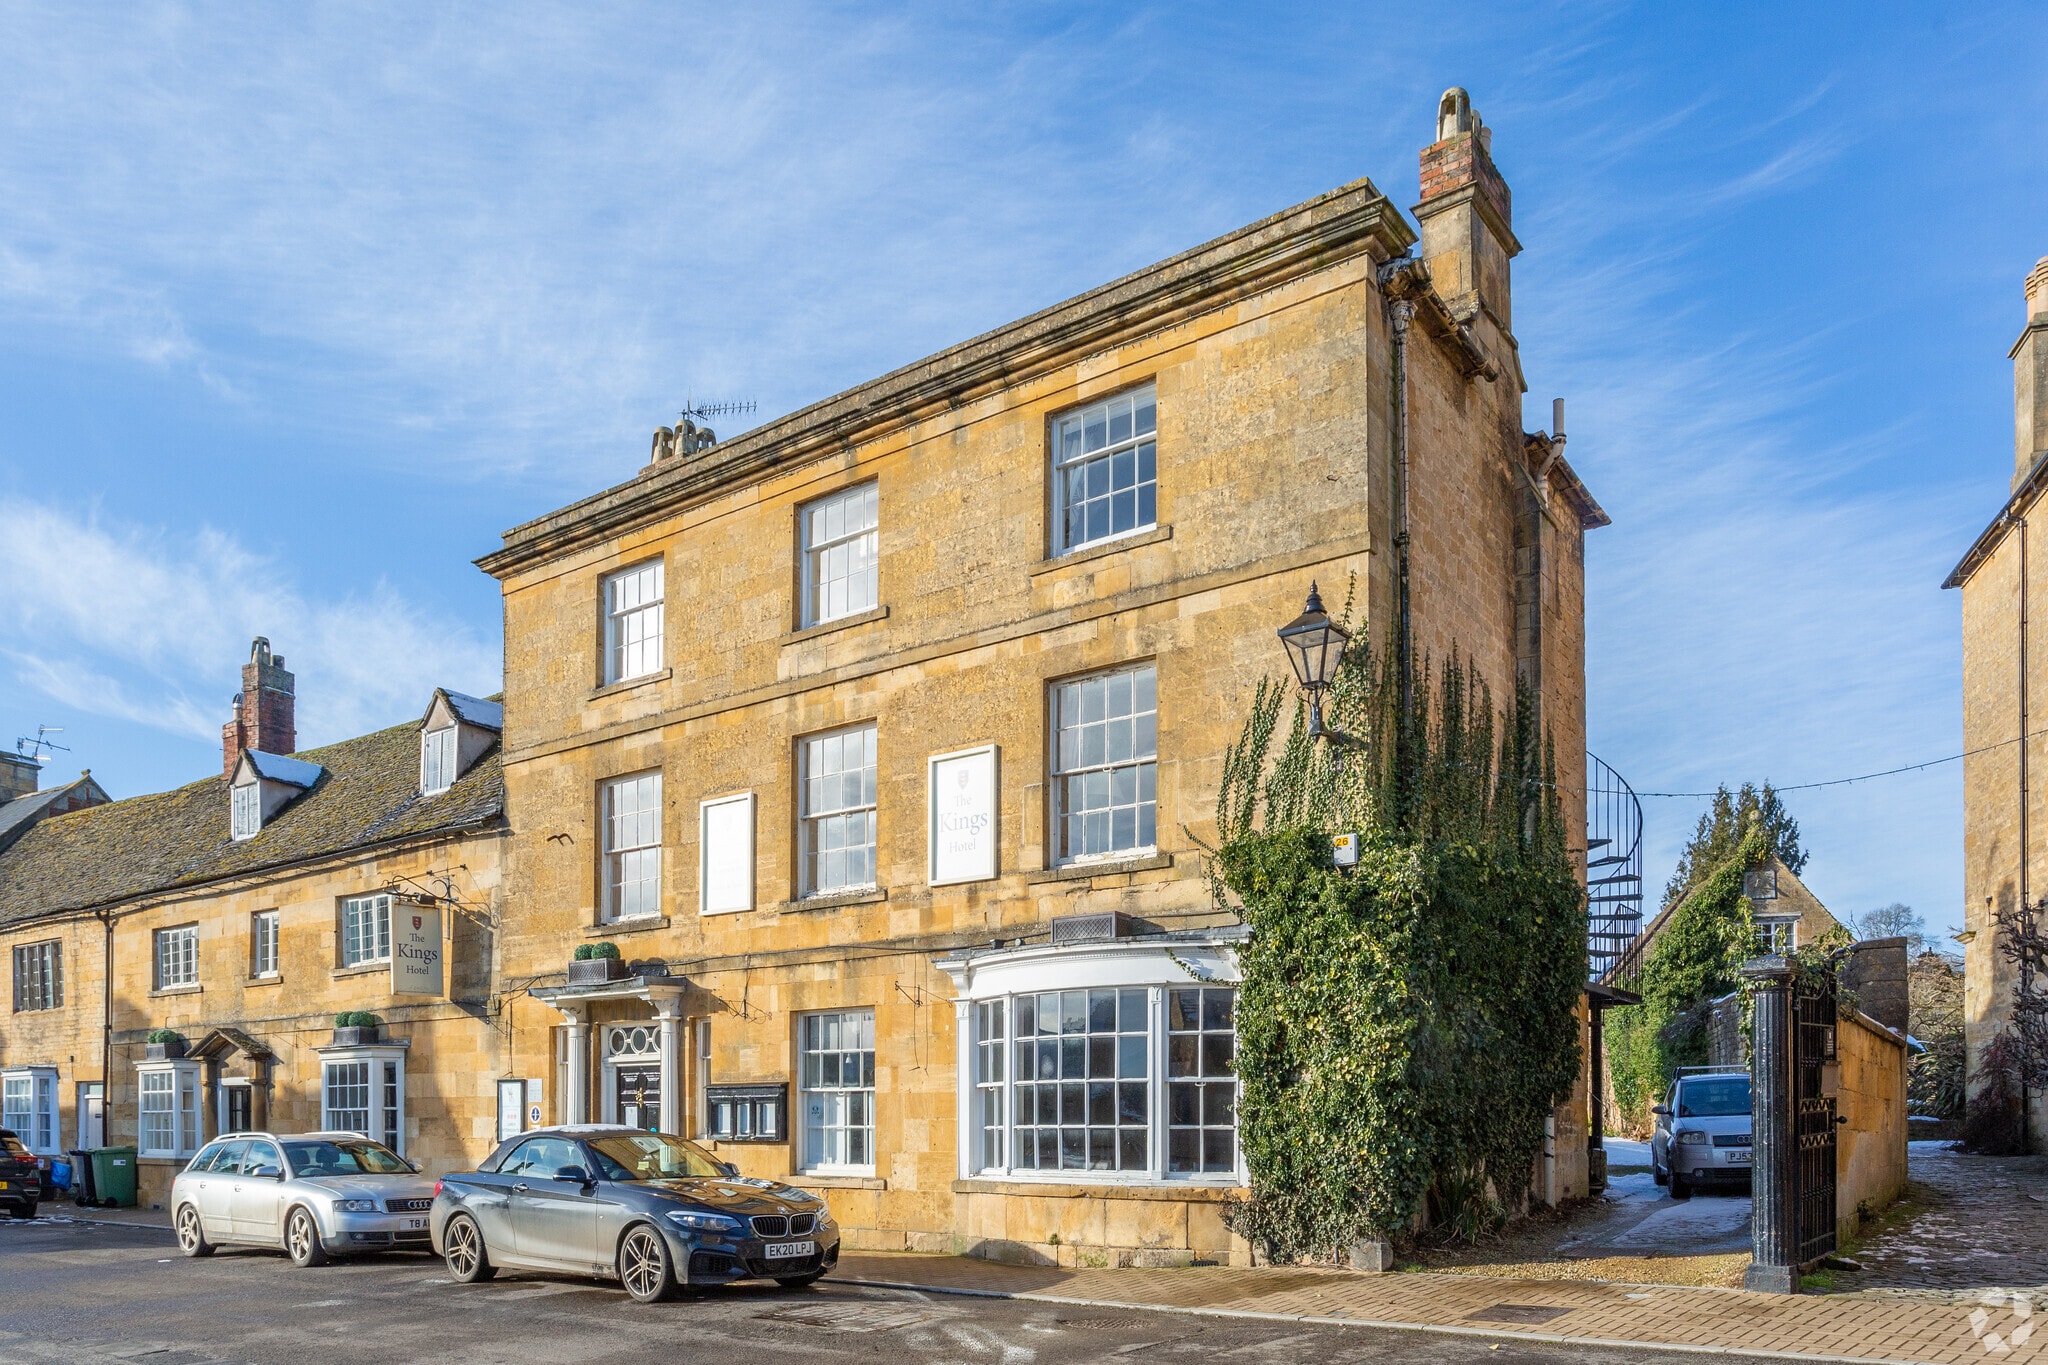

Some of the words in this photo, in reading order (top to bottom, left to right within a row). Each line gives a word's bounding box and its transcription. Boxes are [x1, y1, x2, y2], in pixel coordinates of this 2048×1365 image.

[954, 794, 972, 807] The
[939, 812, 988, 835] Kings
[949, 838, 976, 853] Hotel
[409, 933, 425, 943] The
[397, 943, 438, 965] Kings
[406, 965, 429, 975] Hotel
[409, 1219, 421, 1228] T8
[769, 1244, 794, 1257] EK20
[795, 1243, 812, 1255] LPJ
